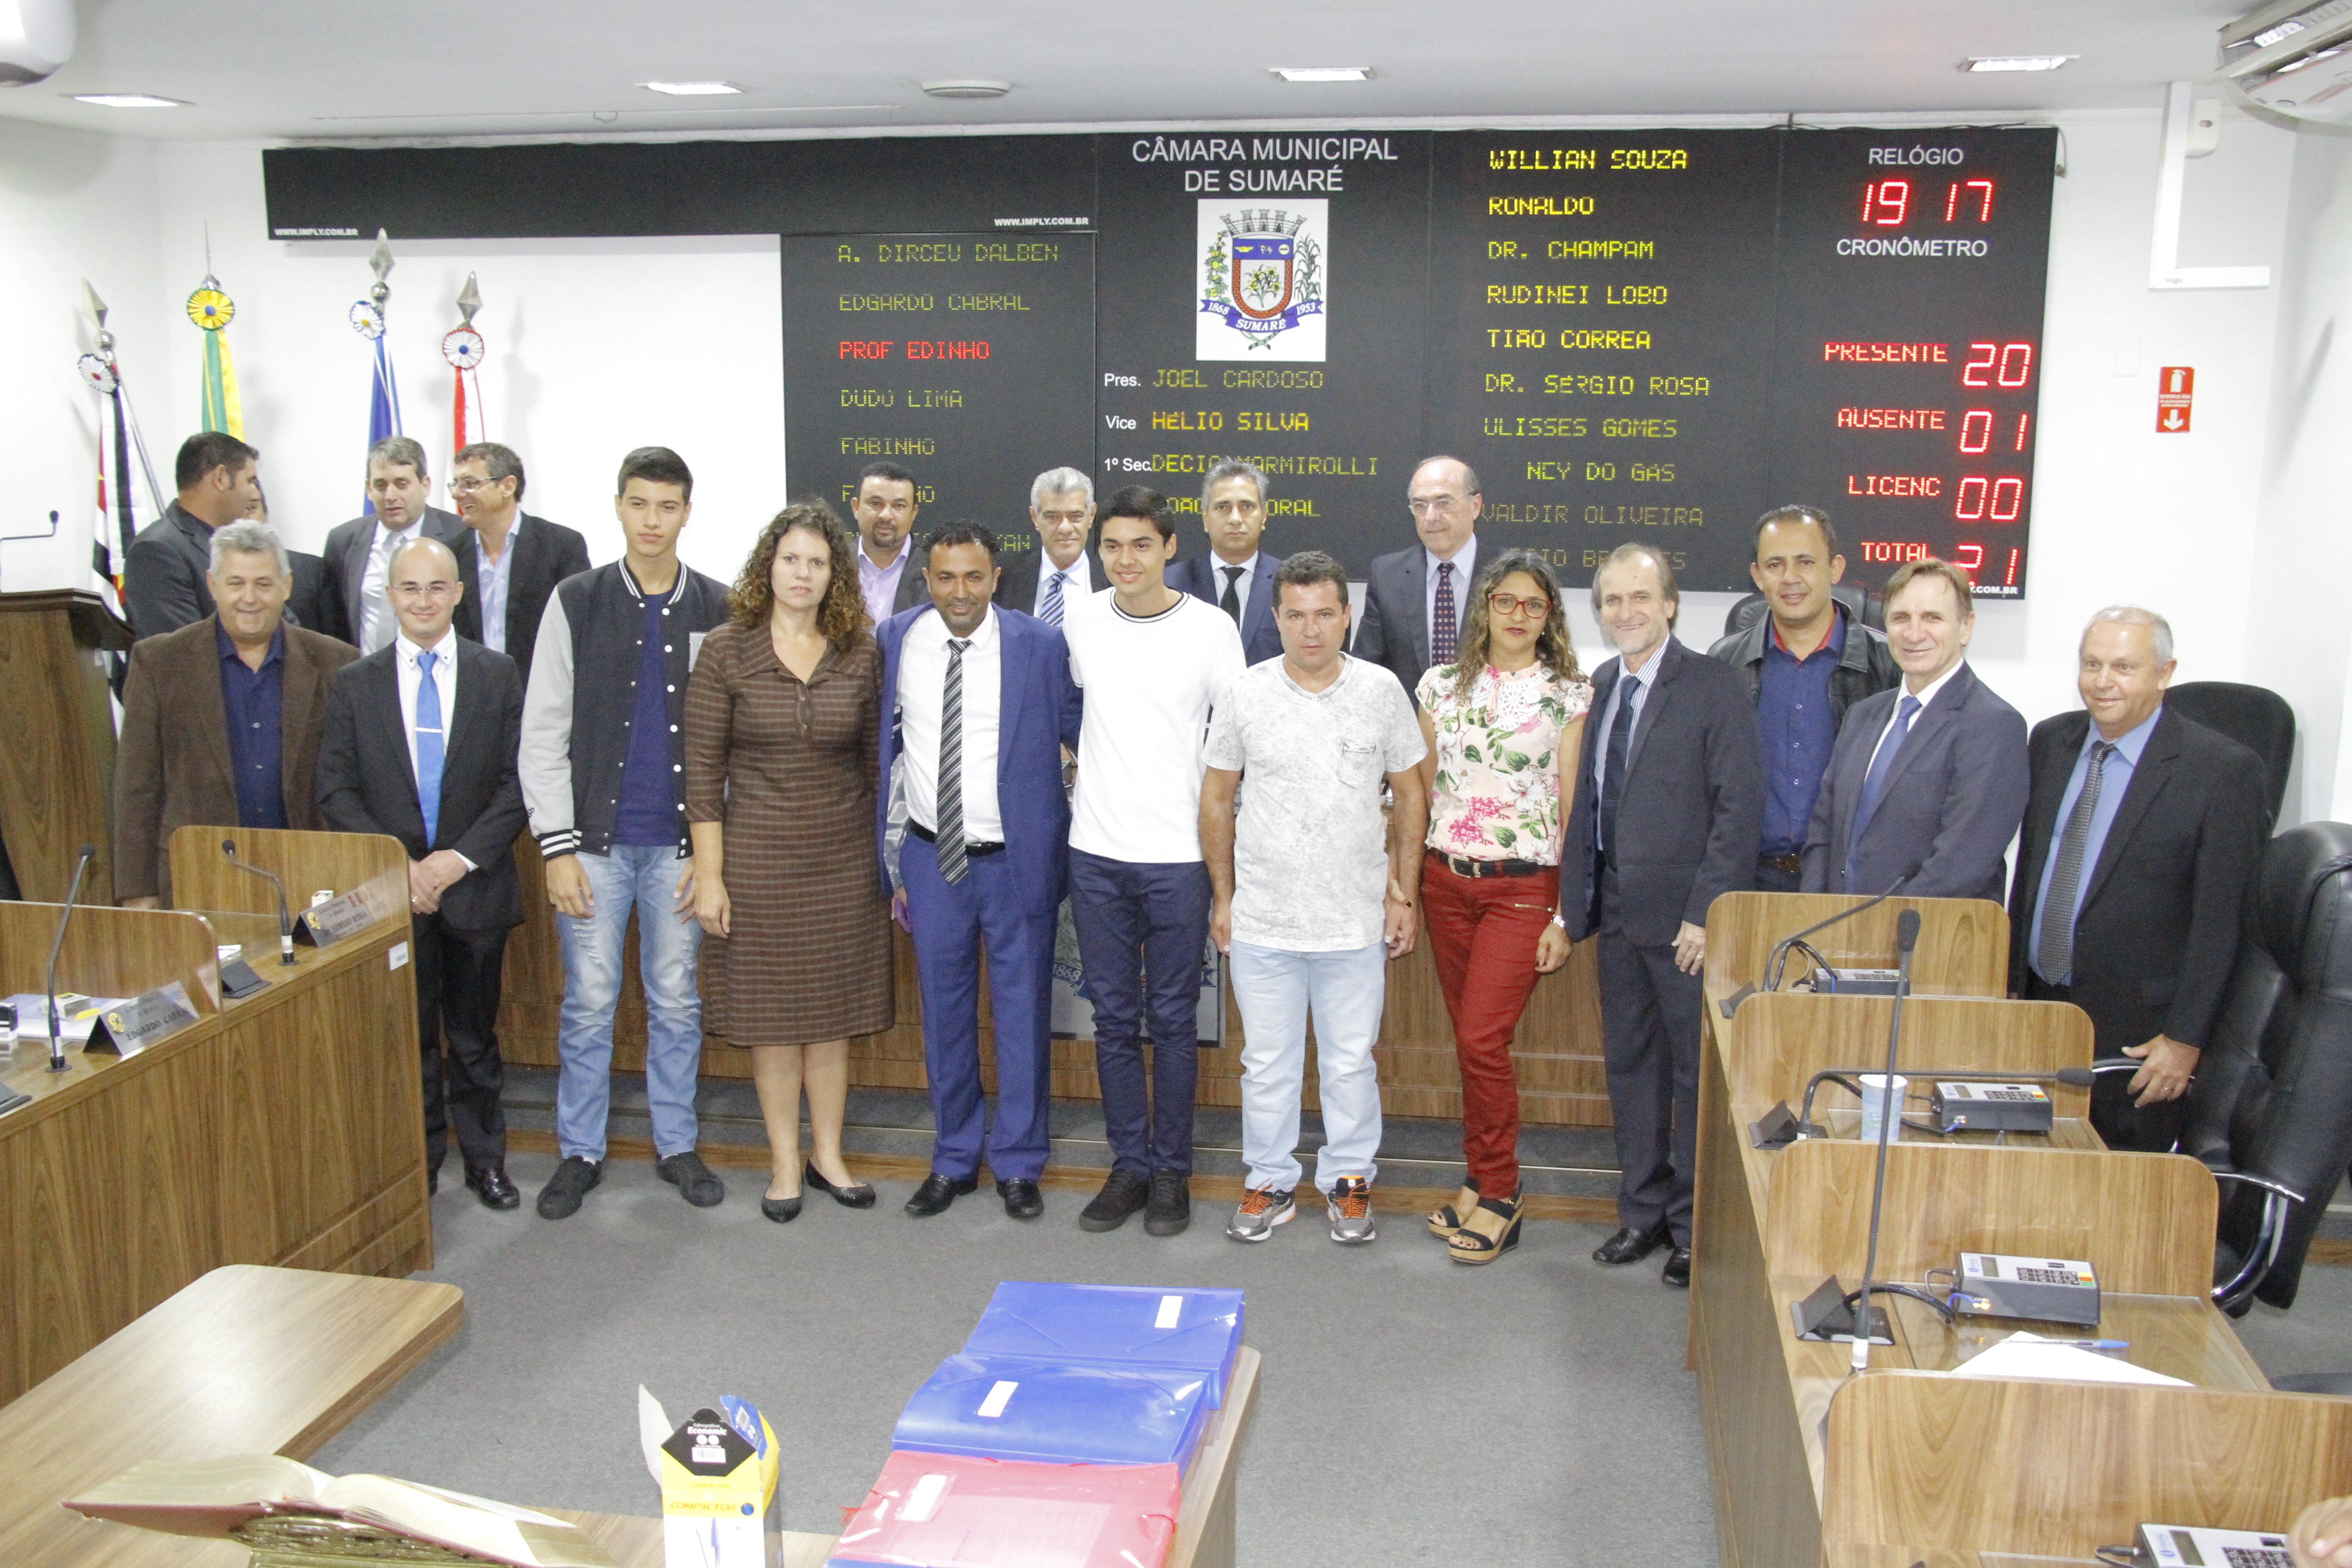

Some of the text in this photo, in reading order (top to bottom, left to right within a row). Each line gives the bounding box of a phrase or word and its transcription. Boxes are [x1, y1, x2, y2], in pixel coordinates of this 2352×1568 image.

[1132, 136, 1398, 162] CÂMARA MUNICIPAL
[1869, 145, 1964, 165] RELÓGIO
[1489, 149, 1689, 170] WILLIAN SOUZA
[1185, 164, 1343, 191] DE SUMARÉ
[1488, 196, 1595, 216] RONALDO
[1862, 181, 1993, 224] 19 17
[994, 217, 1089, 226] WWW.IMPLY.COM.BR
[838, 244, 1058, 262] A. DIRCEU DALBEN
[1488, 240, 1655, 259] DR. CHAMPAM
[1837, 236, 1987, 257] CRONÔMETRO
[839, 294, 1030, 311] EDGARDO CABRAL
[1486, 285, 1669, 305] RUDINEI LOBO
[1207, 301, 1230, 315] 1868
[1296, 302, 1316, 315] 1953
[1235, 318, 1286, 331] SUMARÉ
[1560, 329, 1651, 350] CORREA
[839, 341, 990, 359] PROF EDINHO
[1824, 342, 2032, 387] PRESENTE 20
[1104, 369, 1323, 388] Pres. JOEL CARDOSO
[1485, 373, 1524, 393] DR.
[1649, 376, 1710, 396] ROSA
[841, 389, 963, 407] DUDU LIMA
[1105, 414, 1137, 430] Vice
[1238, 412, 1310, 431] SILVA
[1484, 417, 1677, 437] ULISSES GOMES
[1837, 408, 2028, 453] AUSENTE 01
[841, 437, 935, 455] FABINHO
[1104, 457, 1119, 472] 1º
[1122, 457, 1152, 472] Sec.
[1586, 462, 1616, 481] DO
[1166, 497, 1203, 514] OÃO
[1847, 475, 2023, 520] LICENC 00
[1482, 504, 1703, 526] VALDIR OLIVEIRA
[1958, 544, 2018, 585] 21
[1052, 964, 1082, 982] 1868
[126, 1019, 162, 1041] EDGARDO
[687, 1426, 727, 1436] Economic
[670, 1501, 737, 1511] COMPACTOR
